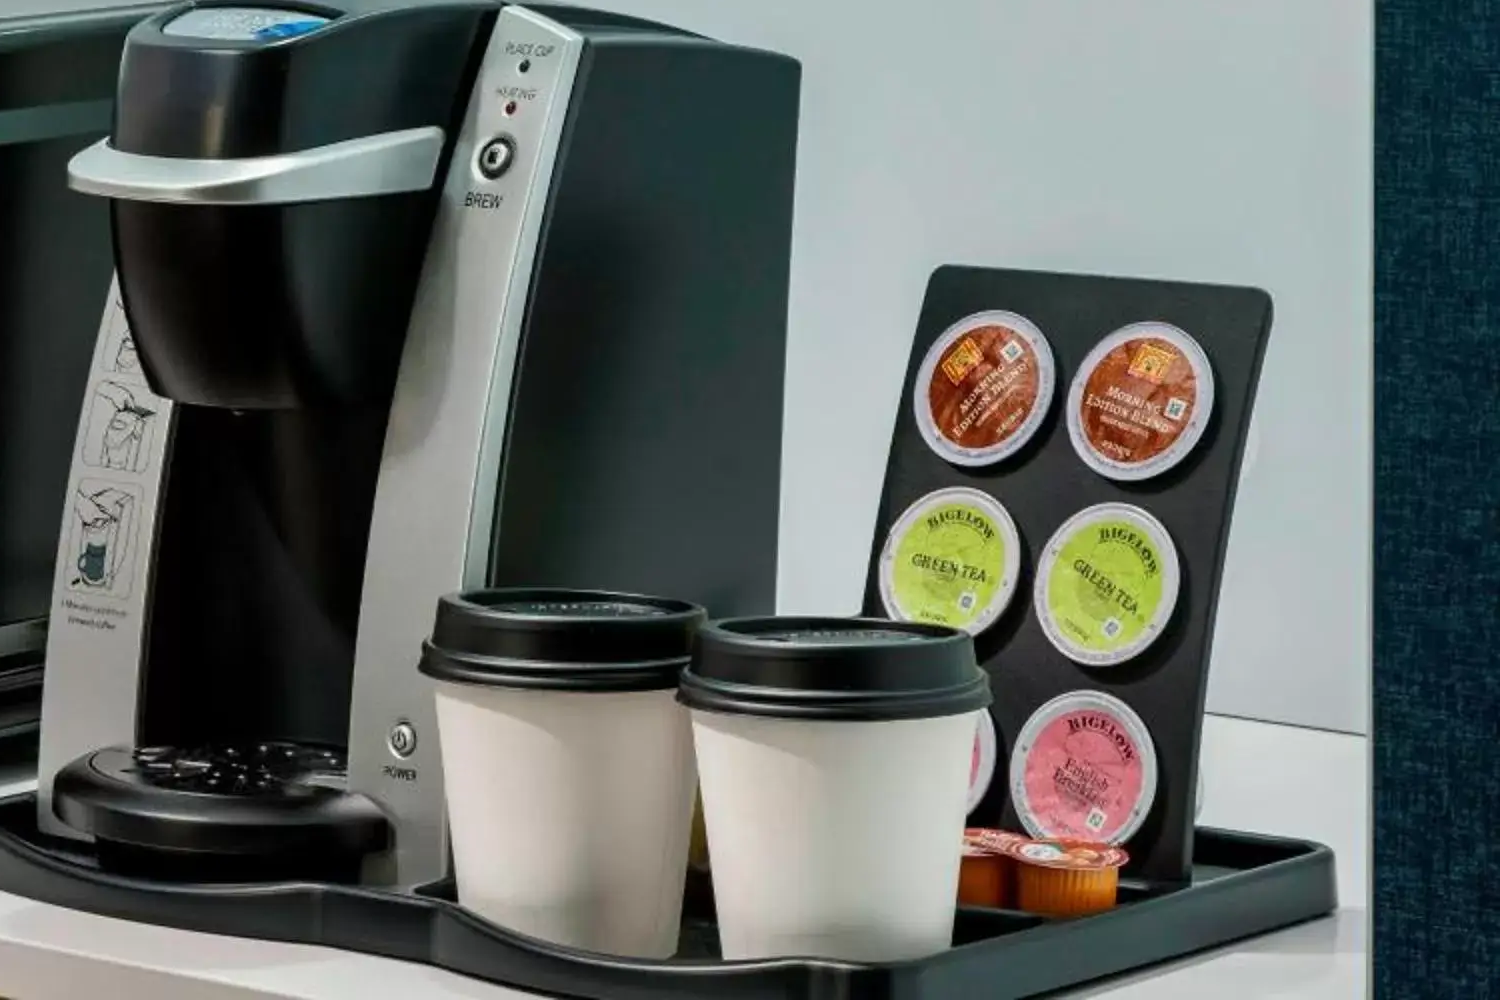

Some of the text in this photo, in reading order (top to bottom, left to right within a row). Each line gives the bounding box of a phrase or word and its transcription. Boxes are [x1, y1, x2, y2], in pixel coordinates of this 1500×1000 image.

[464, 191, 503, 209] BREW
[927, 510, 994, 539] BIGELOW
[1098, 527, 1157, 575] BIGELOW
[911, 553, 986, 583] GREEN TEA
[1074, 558, 1138, 616] GREEN TEA
[1067, 715, 1134, 762] BIGELOW
[382, 765, 417, 781] POWER
